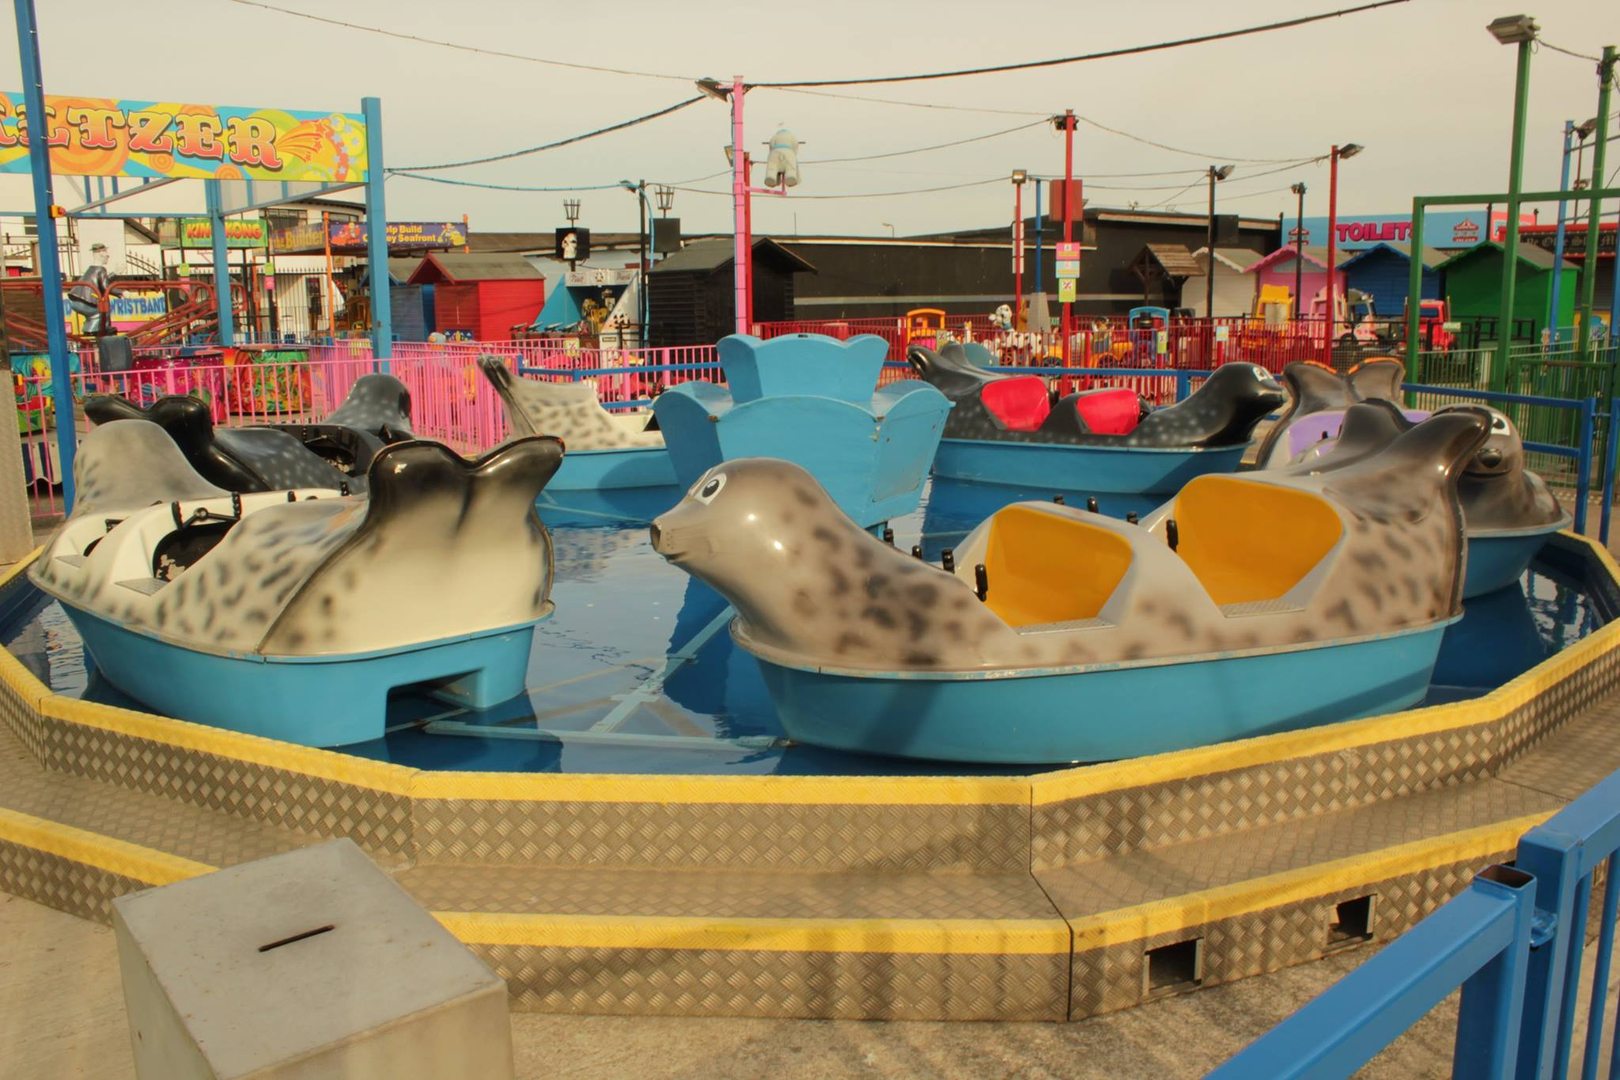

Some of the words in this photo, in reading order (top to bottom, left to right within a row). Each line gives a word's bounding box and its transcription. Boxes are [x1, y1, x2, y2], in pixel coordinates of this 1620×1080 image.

[186, 222, 212, 239] KIN
[399, 225, 423, 234] Build
[398, 233, 436, 243] Seafront
